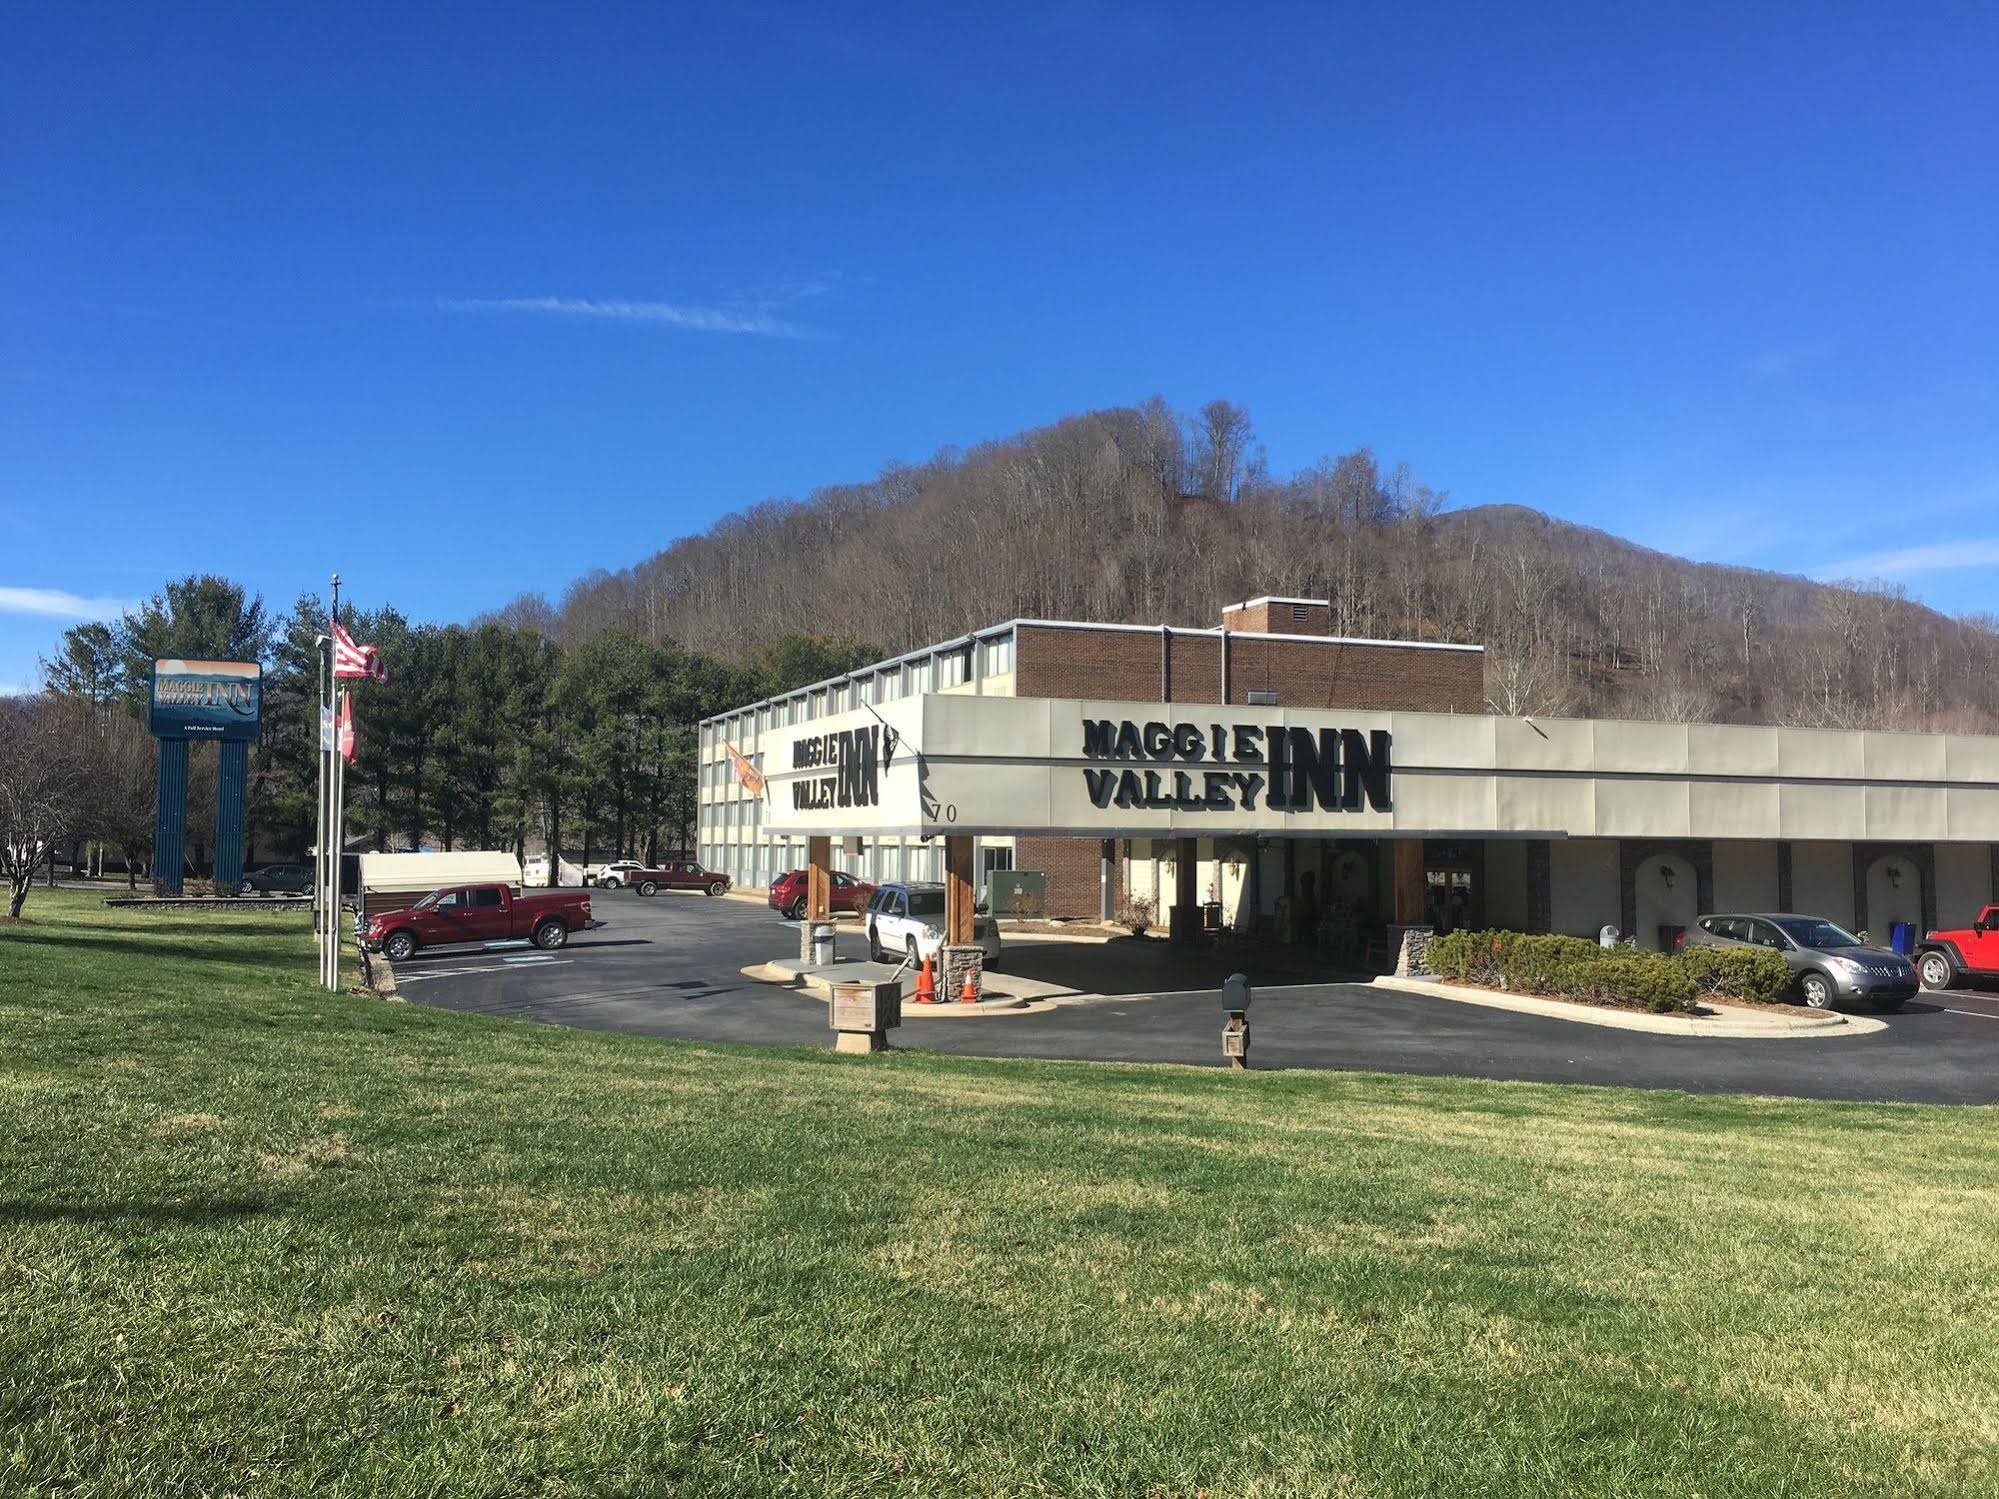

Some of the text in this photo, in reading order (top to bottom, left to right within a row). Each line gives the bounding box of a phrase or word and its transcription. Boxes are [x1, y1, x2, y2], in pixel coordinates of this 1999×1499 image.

[157, 679, 204, 694] MAGGIE
[157, 692, 204, 705] VALLEY
[204, 681, 255, 716] INN
[793, 732, 838, 769] MAGGIE
[1082, 719, 1264, 763] MAGGIE
[837, 724, 879, 808] INN
[1265, 725, 1393, 814] INN
[792, 777, 837, 811] VALLEY
[1082, 768, 1266, 812] VALLEY
[931, 803, 957, 823] 70
